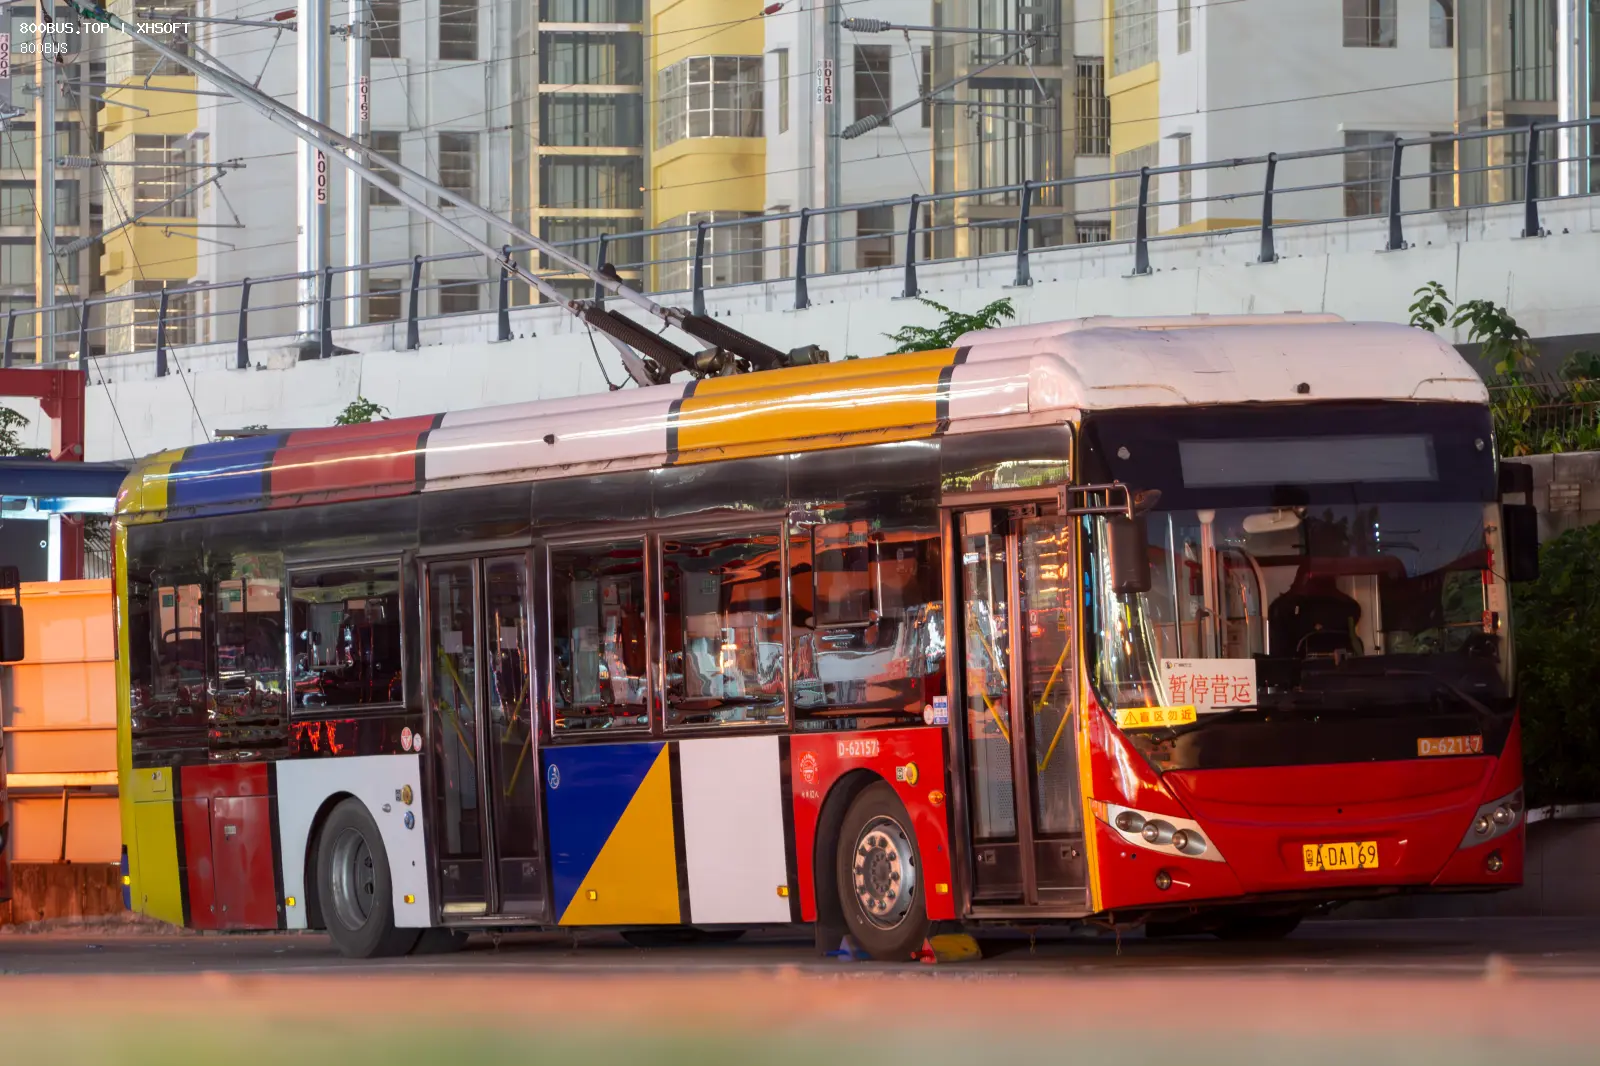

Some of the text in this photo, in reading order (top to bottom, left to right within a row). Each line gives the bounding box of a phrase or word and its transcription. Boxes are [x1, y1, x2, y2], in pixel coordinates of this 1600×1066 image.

[0, 33, 9, 78] 0204
[1168, 673, 1253, 705] 暂停营运
